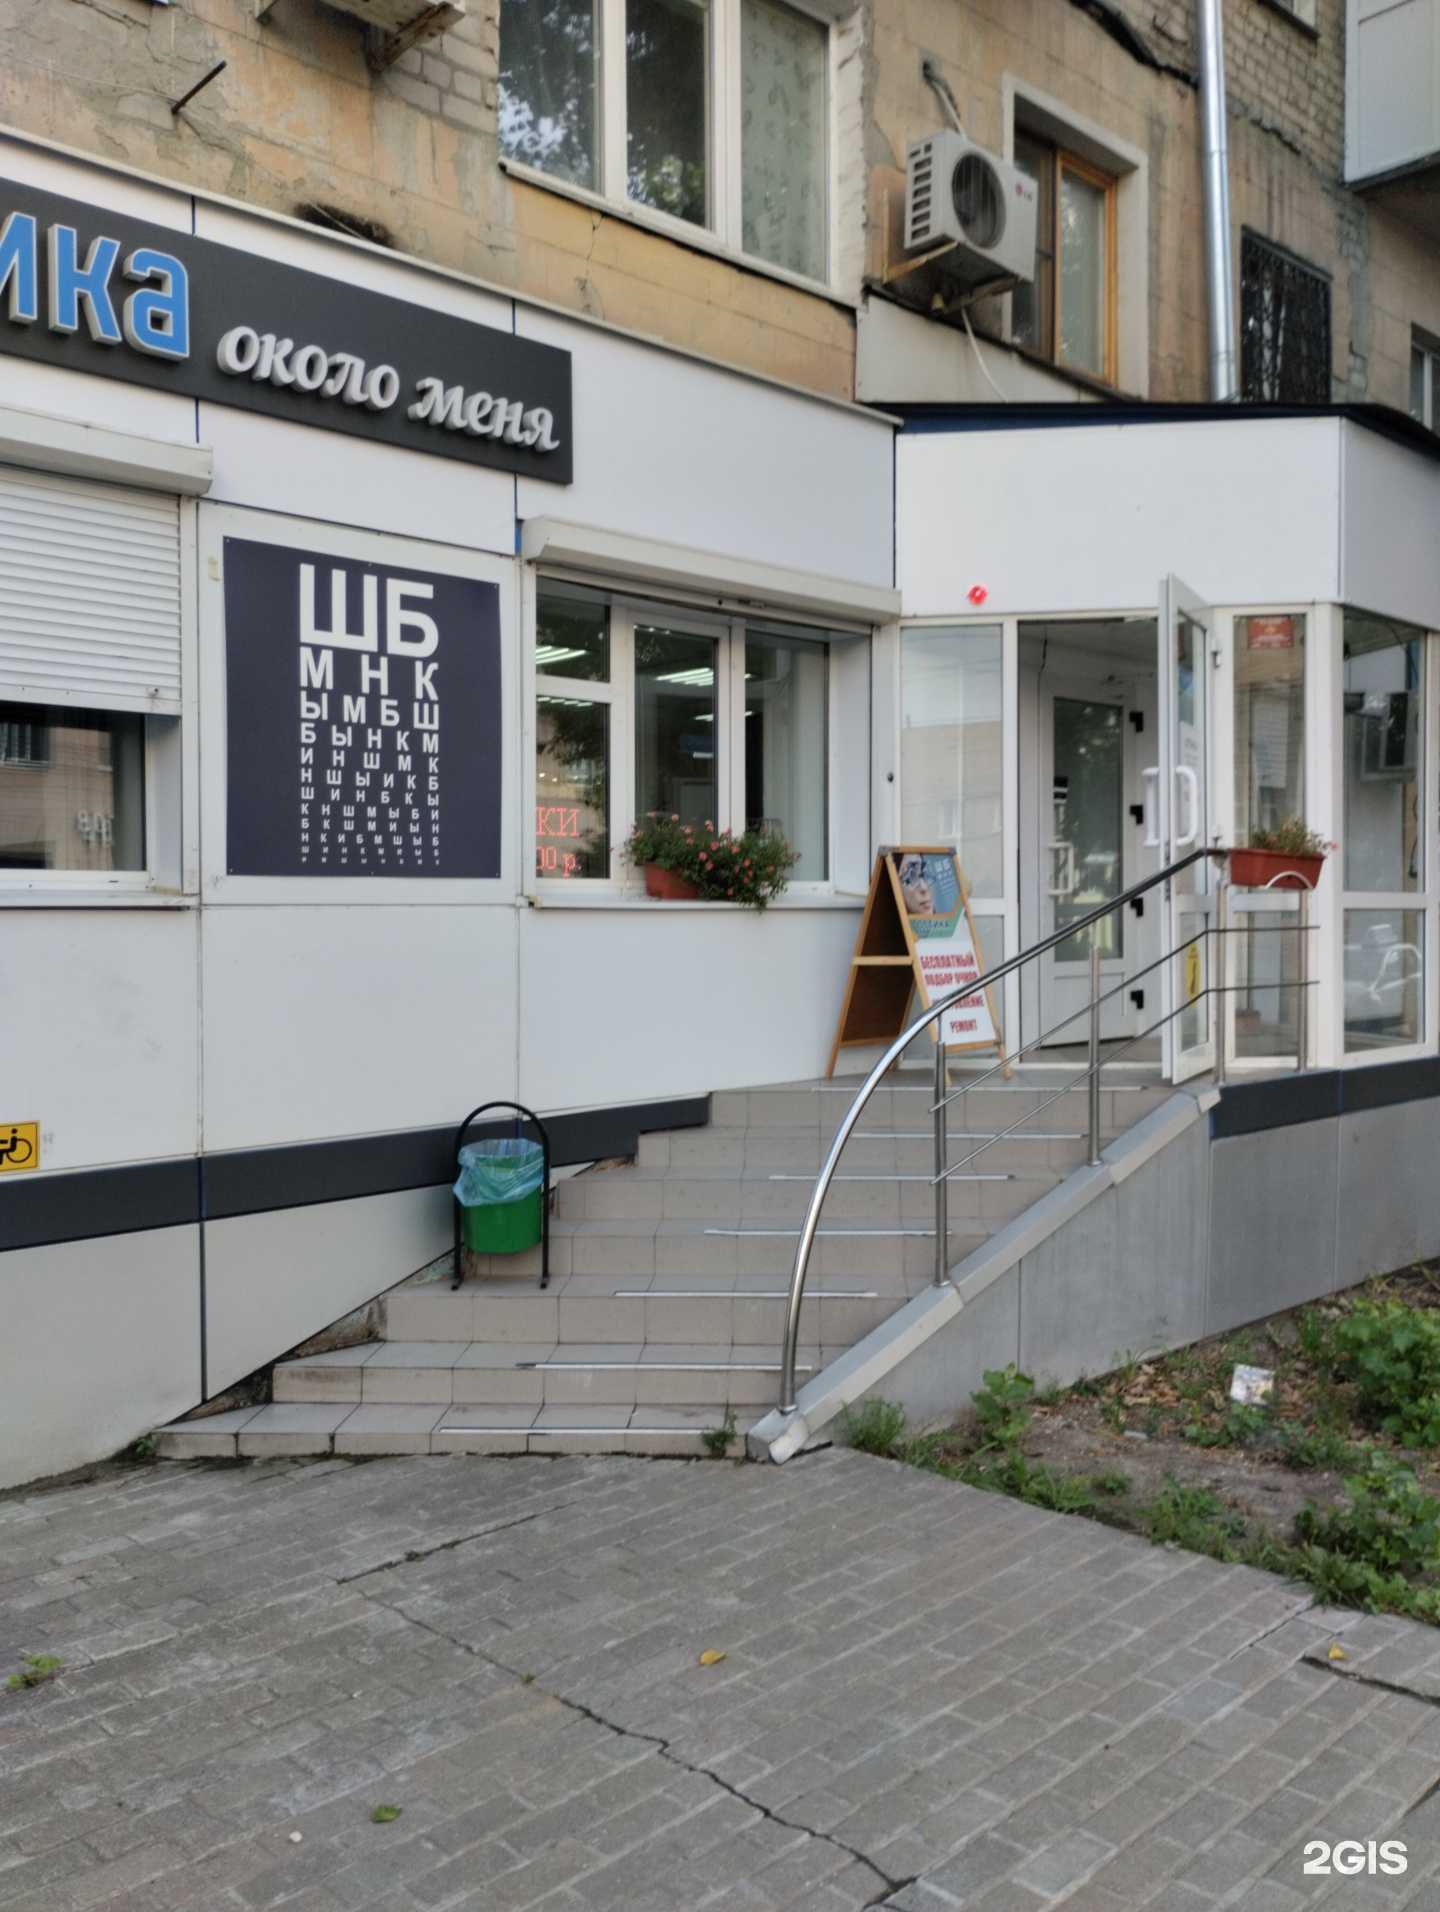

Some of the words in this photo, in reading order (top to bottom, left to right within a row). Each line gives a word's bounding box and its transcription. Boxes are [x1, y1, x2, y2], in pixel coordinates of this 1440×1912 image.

[216, 326, 400, 412] около
[407, 376, 561, 452] меня
[300, 563, 439, 658] ШБ
[300, 646, 333, 690] М
[361, 654, 388, 696] Н
[415, 660, 438, 701] К
[300, 690, 328, 720] Ы
[343, 695, 366, 724] М
[381, 699, 400, 726] Б
[413, 702, 439, 730] Ш
[301, 722, 316, 743] Б
[332, 725, 352, 747] Ы
[368, 728, 382, 749] Н
[397, 731, 409, 751] К
[423, 733, 439, 753] М
[301, 747, 313, 764] И
[333, 750, 344, 767] Н
[364, 752, 380, 769] Ш
[398, 755, 411, 771] М
[429, 757, 438, 773] К
[301, 768, 312, 783] Н
[327, 769, 341, 785] Ш
[356, 772, 370, 786] Ы
[384, 773, 394, 788] И
[407, 775, 416, 789] К
[429, 776, 439, 791] Б
[301, 787, 314, 799] Ш
[331, 788, 340, 800] И
[356, 790, 365, 802] Н
[381, 791, 390, 803] Б
[405, 792, 413, 804] К
[427, 794, 439, 806] Ы
